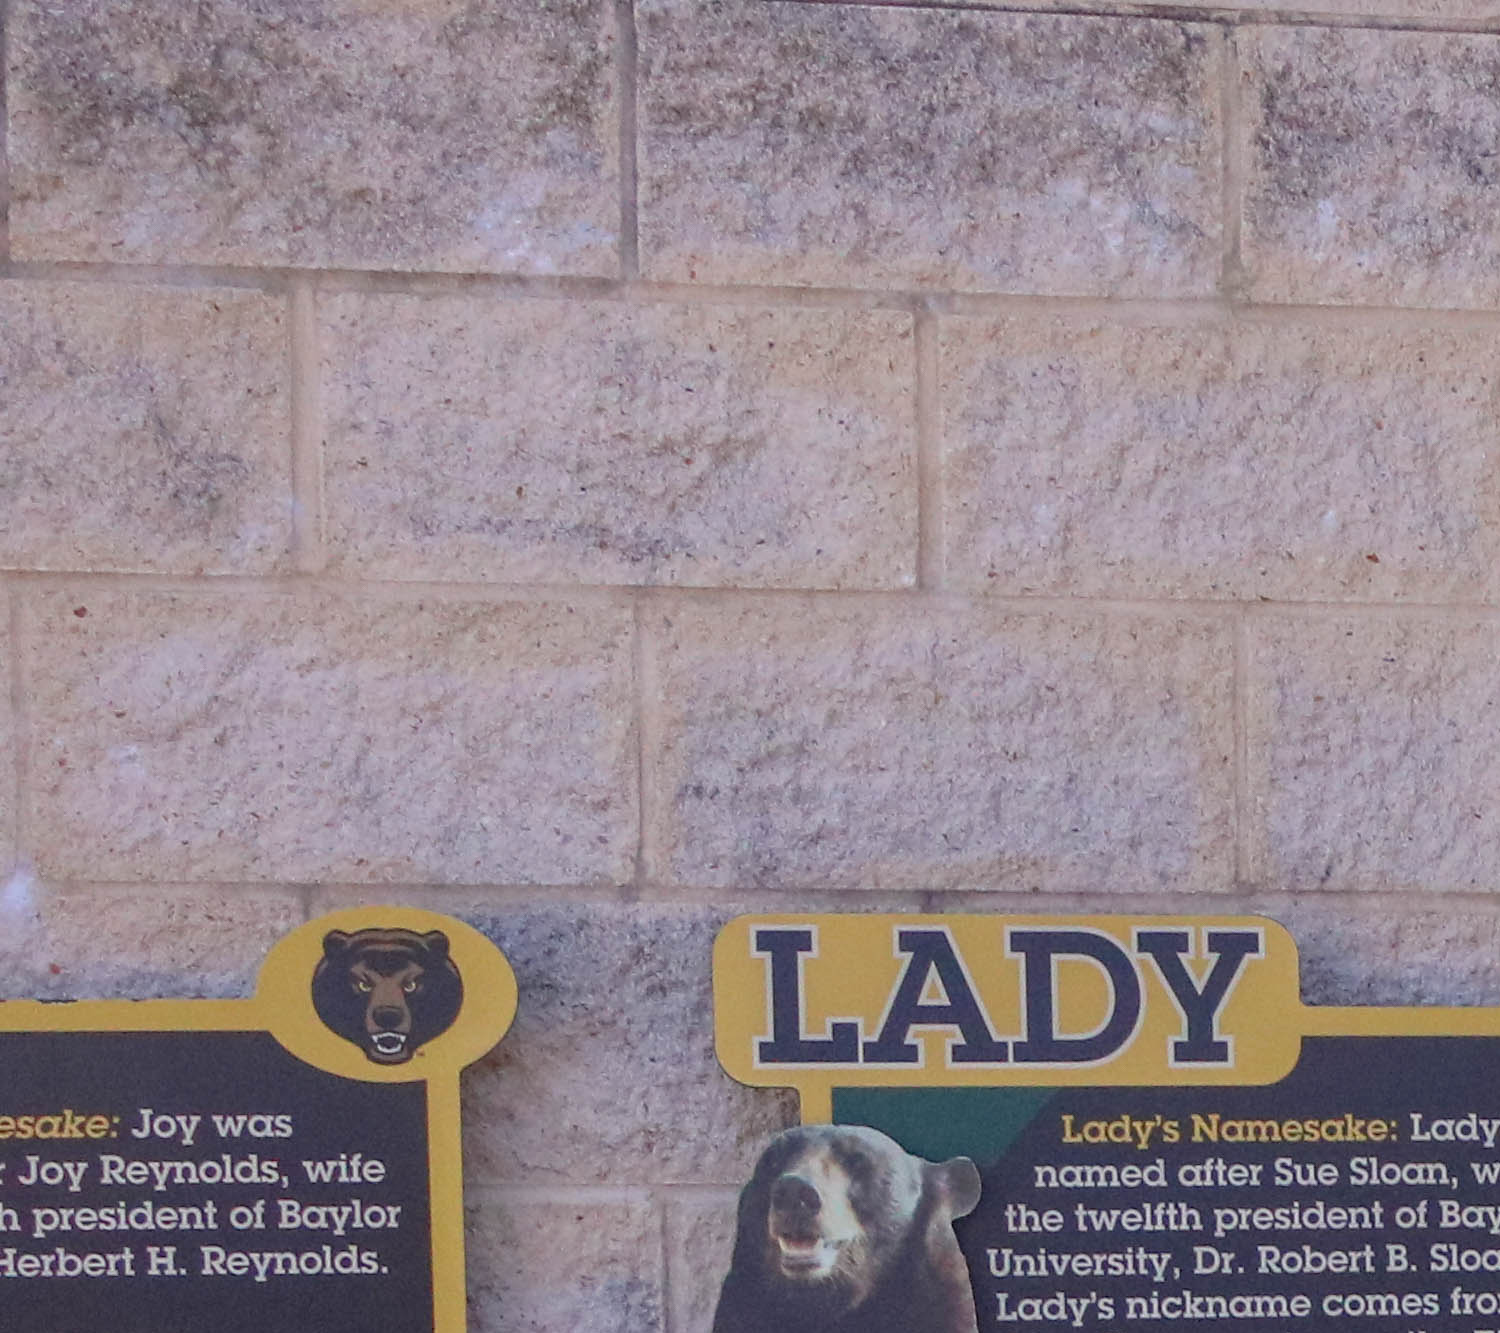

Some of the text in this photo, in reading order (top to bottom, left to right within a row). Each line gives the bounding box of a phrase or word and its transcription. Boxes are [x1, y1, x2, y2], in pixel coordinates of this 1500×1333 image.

[751, 926, 1264, 1067] LADY
[0, 1108, 293, 1147] esake: Joy was
[1061, 1113, 1180, 1150] Lady's
[1191, 1113, 1397, 1143] Namesake:
[17, 1155, 89, 1193] Joy
[99, 1153, 289, 1192] Reynolds,
[301, 1152, 386, 1184] wife
[1034, 1158, 1168, 1189] named
[1177, 1156, 1263, 1188] after
[1274, 1157, 1339, 1187] Sue
[1349, 1156, 1458, 1190] Sloan,
[31, 1199, 219, 1240] president
[229, 1199, 266, 1231] of
[277, 1198, 402, 1237] Baylor
[1004, 1203, 1064, 1233] the
[1074, 1201, 1204, 1233] twelfth
[1213, 1199, 1385, 1238] president
[1395, 1199, 1428, 1229] of
[0, 1244, 388, 1283] Herbert H. Reynolds.
[986, 1246, 1180, 1283] University,
[1192, 1244, 1245, 1276] Dr.
[1257, 1243, 1375, 1275] Robert
[1385, 1243, 1417, 1272] B.
[995, 1291, 1115, 1328] Lady's
[1125, 1289, 1312, 1320] nickname
[1322, 1293, 1440, 1318] comes
